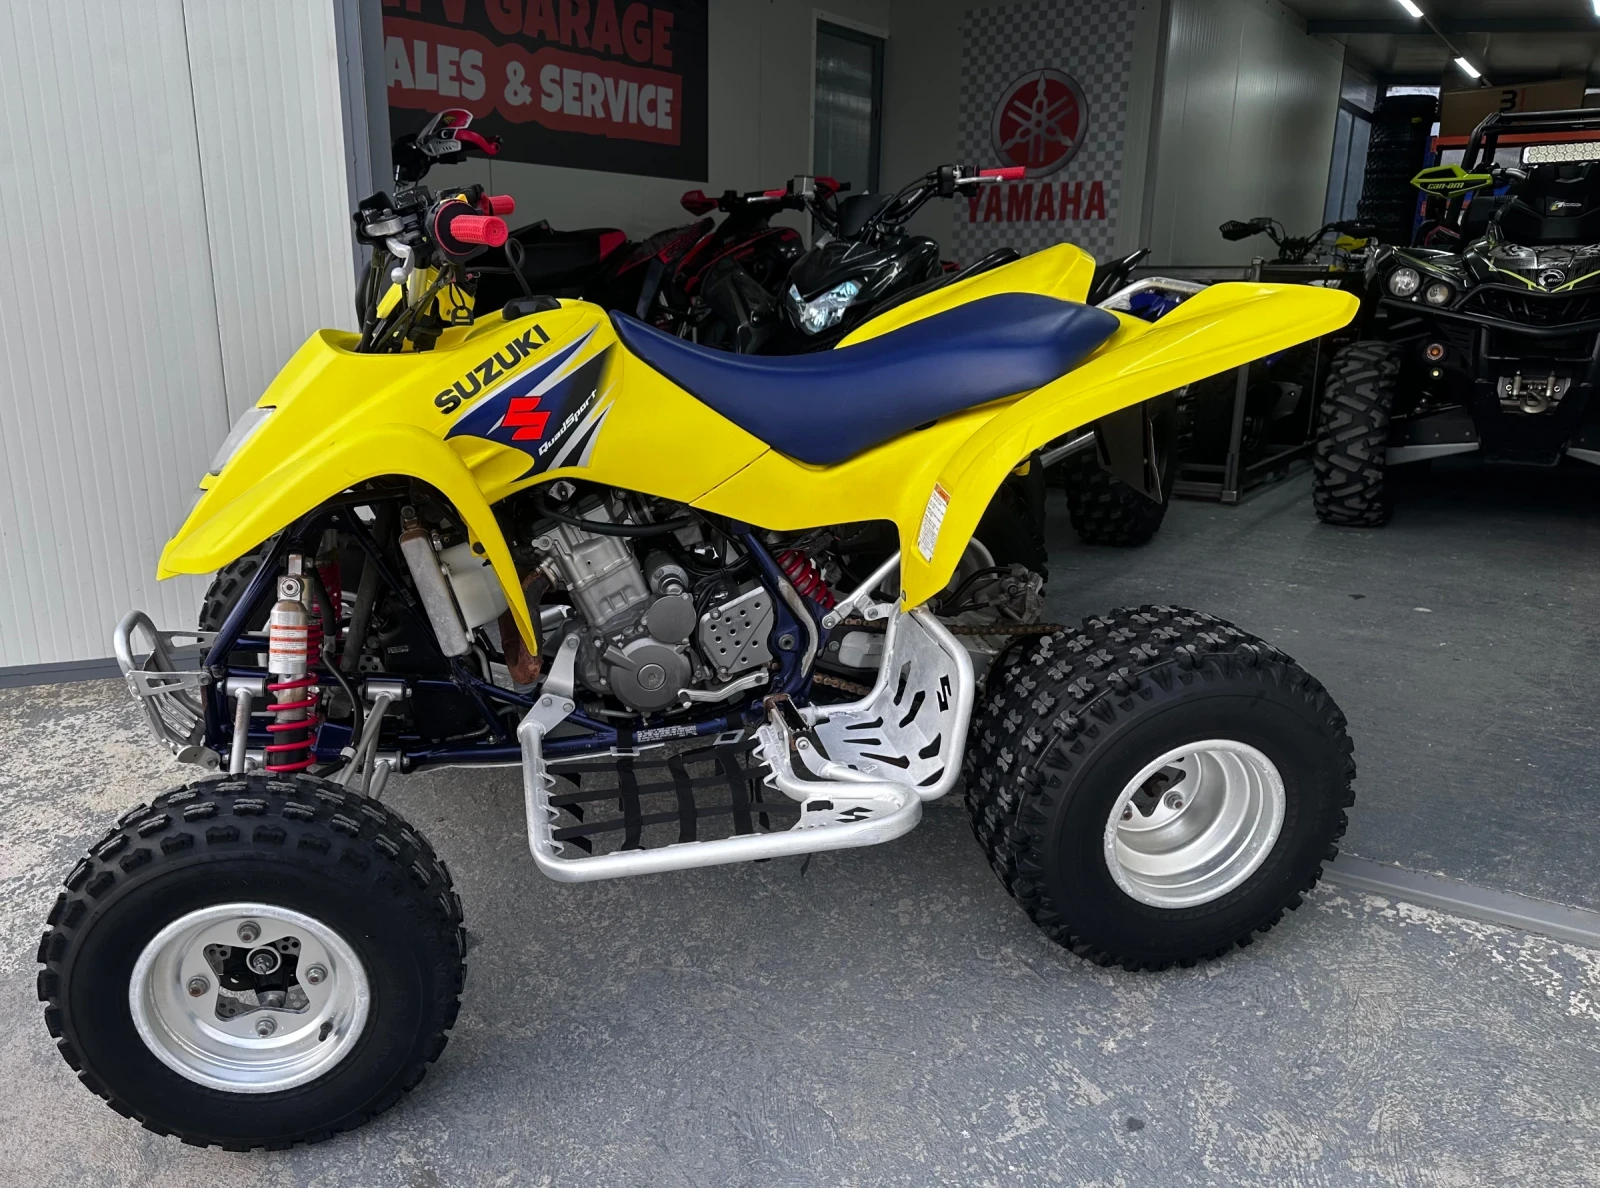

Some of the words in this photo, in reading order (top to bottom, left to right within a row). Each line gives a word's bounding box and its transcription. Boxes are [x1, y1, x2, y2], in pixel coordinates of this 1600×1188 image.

[485, 0, 675, 67] GARAGE
[504, 60, 533, 107] &
[540, 65, 673, 130] SERVICE
[967, 180, 1106, 223] YAMAHA
[1427, 182, 1465, 190] can-am
[434, 324, 551, 415] SUZUKI
[538, 388, 598, 457] QuadSport
